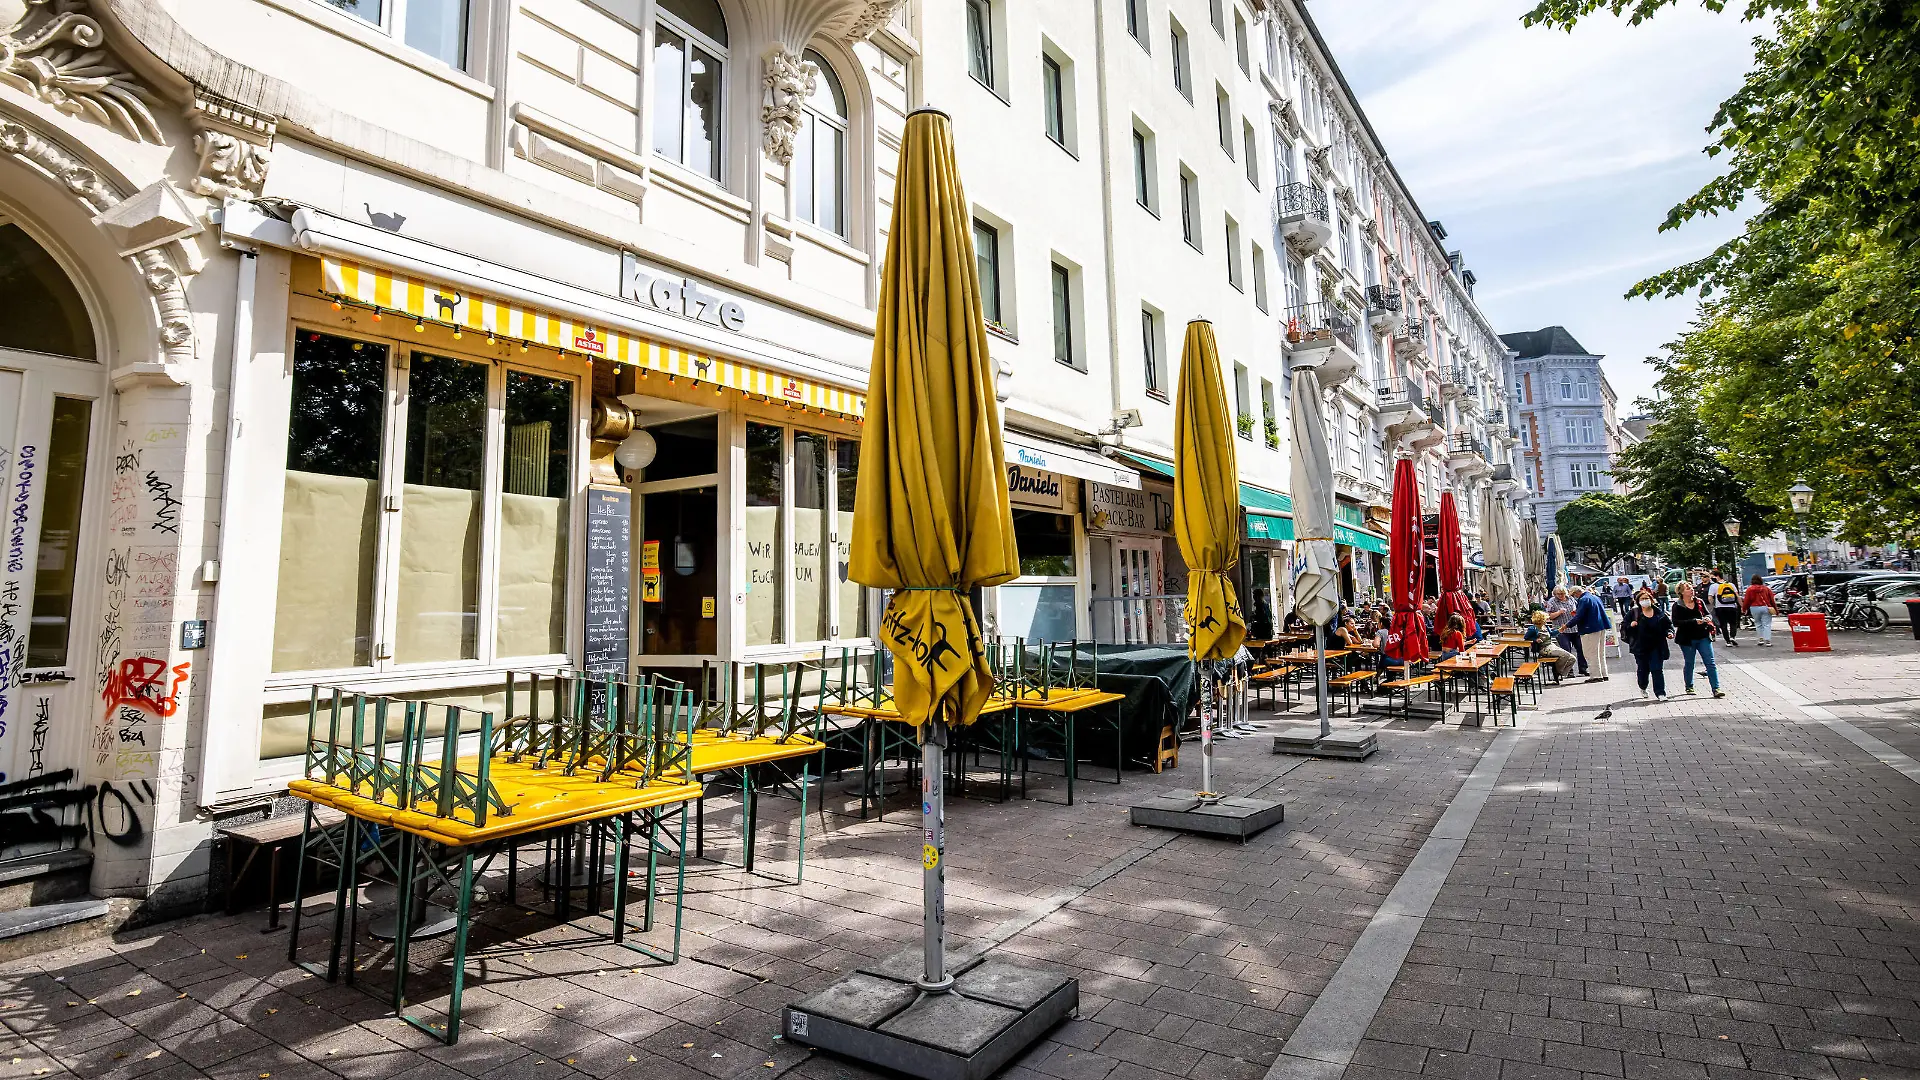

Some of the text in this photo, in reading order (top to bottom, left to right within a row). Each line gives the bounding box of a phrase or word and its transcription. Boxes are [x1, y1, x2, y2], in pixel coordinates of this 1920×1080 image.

[619, 251, 746, 332] katze
[577, 339, 602, 351] ASTRA
[1018, 448, 1047, 467] Daniela
[1008, 464, 1059, 497] Daniela
[1092, 482, 1172, 531] PASTELARIA TR
[795, 567, 813, 582] UM
